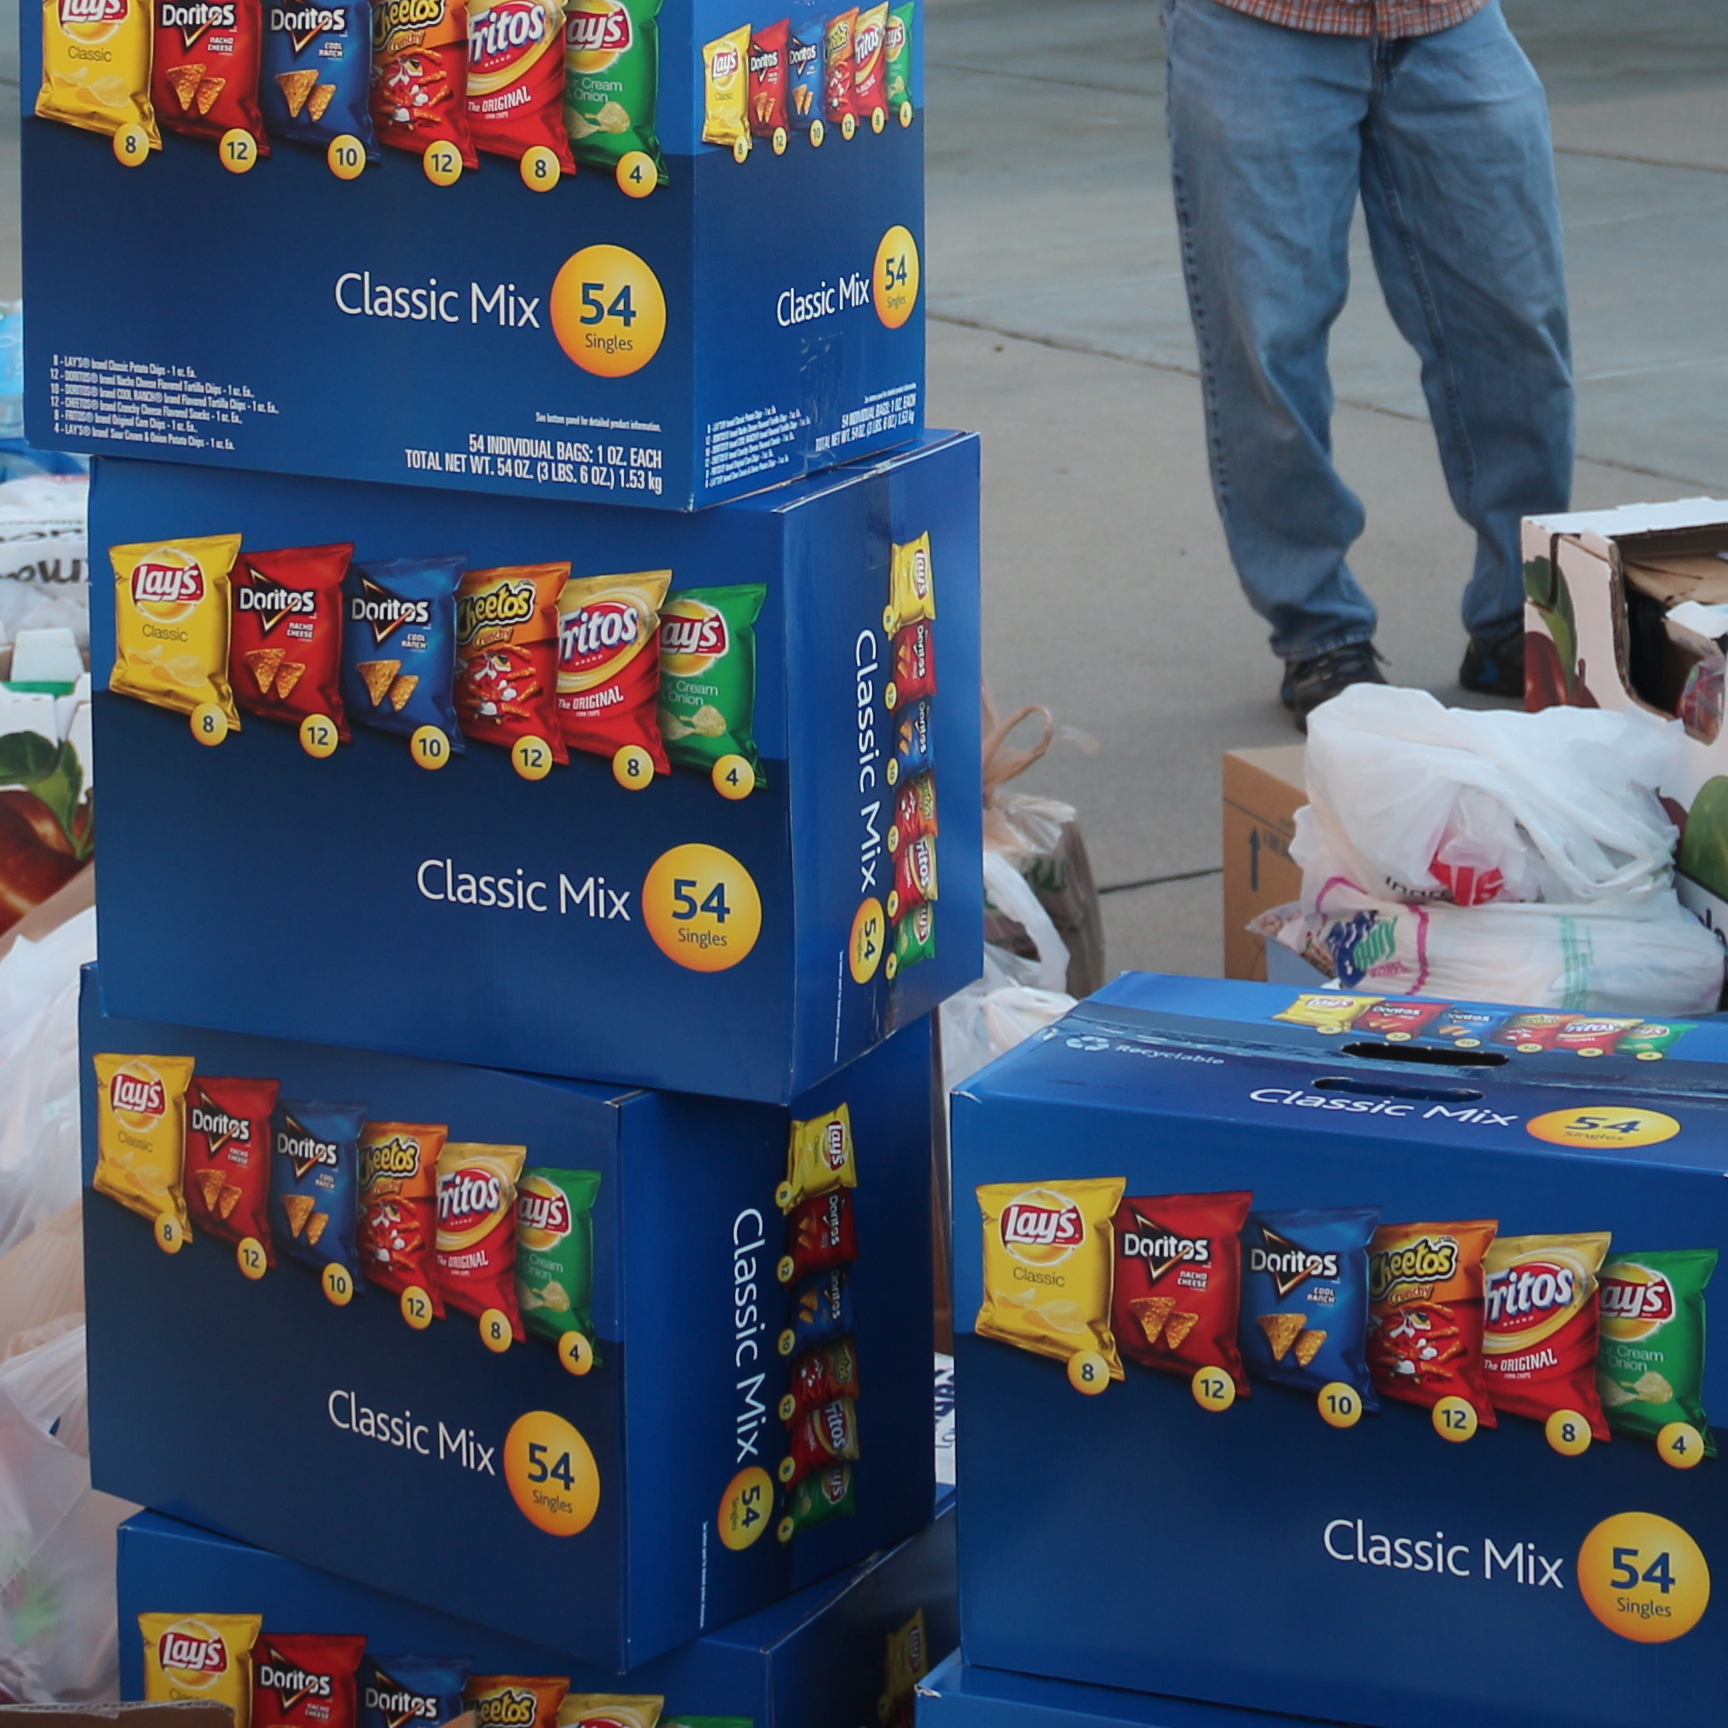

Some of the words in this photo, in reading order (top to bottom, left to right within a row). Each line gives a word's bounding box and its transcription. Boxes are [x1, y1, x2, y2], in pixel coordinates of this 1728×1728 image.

[162, 2, 235, 27] Doritos
[271, 6, 345, 32] Doritos
[68, 45, 112, 62] Classic
[207, 43, 234, 53] CHEESE
[482, 86, 531, 113] ORIGINAL
[125, 136, 137, 154] 8
[227, 141, 249, 161] 12
[335, 147, 358, 166] 10
[431, 153, 453, 173] 12
[534, 160, 547, 178] 8
[629, 165, 643, 184] 4
[885, 254, 908, 291] 54
[335, 271, 459, 323] Classic
[471, 282, 540, 328] Mix
[579, 282, 637, 328] 54
[777, 281, 835, 327] Classic
[839, 272, 870, 311] Mix
[585, 333, 634, 354] Singles
[469, 434, 484, 453] 54
[488, 435, 554, 460] INDIVIDUAL
[557, 441, 593, 463] BAGS:
[597, 445, 603, 463] 1
[607, 446, 627, 466] OZ.
[630, 448, 662, 469] EACH
[405, 449, 442, 471] TOTAL
[445, 453, 467, 473] NET
[470, 456, 494, 476] WT.
[497, 458, 513, 477] 54
[514, 459, 534, 479] OZ.
[551, 463, 577, 484] LBS.
[580, 465, 588, 484] 6
[591, 466, 615, 489] OZ.)
[619, 469, 645, 490] 1.53
[648, 470, 663, 495] kg
[135, 565, 199, 603] Lay's
[240, 587, 314, 612] Doritos
[352, 598, 429, 623] Doritos
[142, 624, 189, 643] Classic
[573, 686, 624, 711] ORIGINAL
[676, 681, 719, 697] Cream
[202, 715, 215, 733] 8
[856, 629, 879, 794] Classic
[307, 727, 329, 747] 12
[418, 738, 441, 758] 10
[520, 748, 543, 768] 12
[627, 758, 639, 777] 8
[725, 767, 739, 786] 4
[860, 800, 882, 893] Mix
[417, 858, 547, 912] Classic
[559, 874, 631, 922] Mix
[671, 878, 731, 924] 54
[678, 928, 728, 949] Singles
[1115, 1043, 1225, 1065] Recyclable
[113, 1075, 164, 1114] Lay's
[1249, 1087, 1414, 1118] Classic
[1422, 1104, 1520, 1127] Mix
[192, 1109, 250, 1141] Doritos
[1564, 1115, 1642, 1135] 54
[277, 1133, 338, 1165] Doritos
[1005, 1206, 1077, 1245] Lay's
[1124, 1233, 1209, 1261] Doritos
[1251, 1248, 1337, 1277] Doritos
[733, 1207, 766, 1368] Classic
[1013, 1266, 1066, 1288] Classic
[1177, 1279, 1208, 1289] CHEESE
[1180, 1271, 1208, 1280] NACHO
[1306, 1293, 1336, 1304] RANCH
[1312, 1286, 1335, 1296] COOL
[1389, 1286, 1433, 1305] Crunchy
[1500, 1348, 1558, 1373] ORIGINAL
[1617, 1345, 1664, 1362] Cream
[1081, 1364, 1094, 1383] 8
[1200, 1379, 1225, 1399] 12
[1327, 1394, 1352, 1414] 10
[736, 1372, 766, 1464] Mix
[1442, 1410, 1467, 1430] 12
[328, 1389, 430, 1455] Classic
[438, 1421, 495, 1476] Mix
[1562, 1423, 1575, 1442] 8
[1671, 1435, 1687, 1455] 4
[527, 1441, 575, 1492] 54
[532, 1489, 573, 1514] Singles
[741, 1484, 761, 1528] 54
[1323, 1518, 1470, 1577] Classic
[1484, 1538, 1565, 1590] Mix
[1610, 1546, 1677, 1594] 54
[1616, 1597, 1672, 1620] Singles
[162, 1633, 222, 1670] Lay's
[260, 1665, 331, 1696] Doritos
[365, 1687, 438, 1718] Doritos
